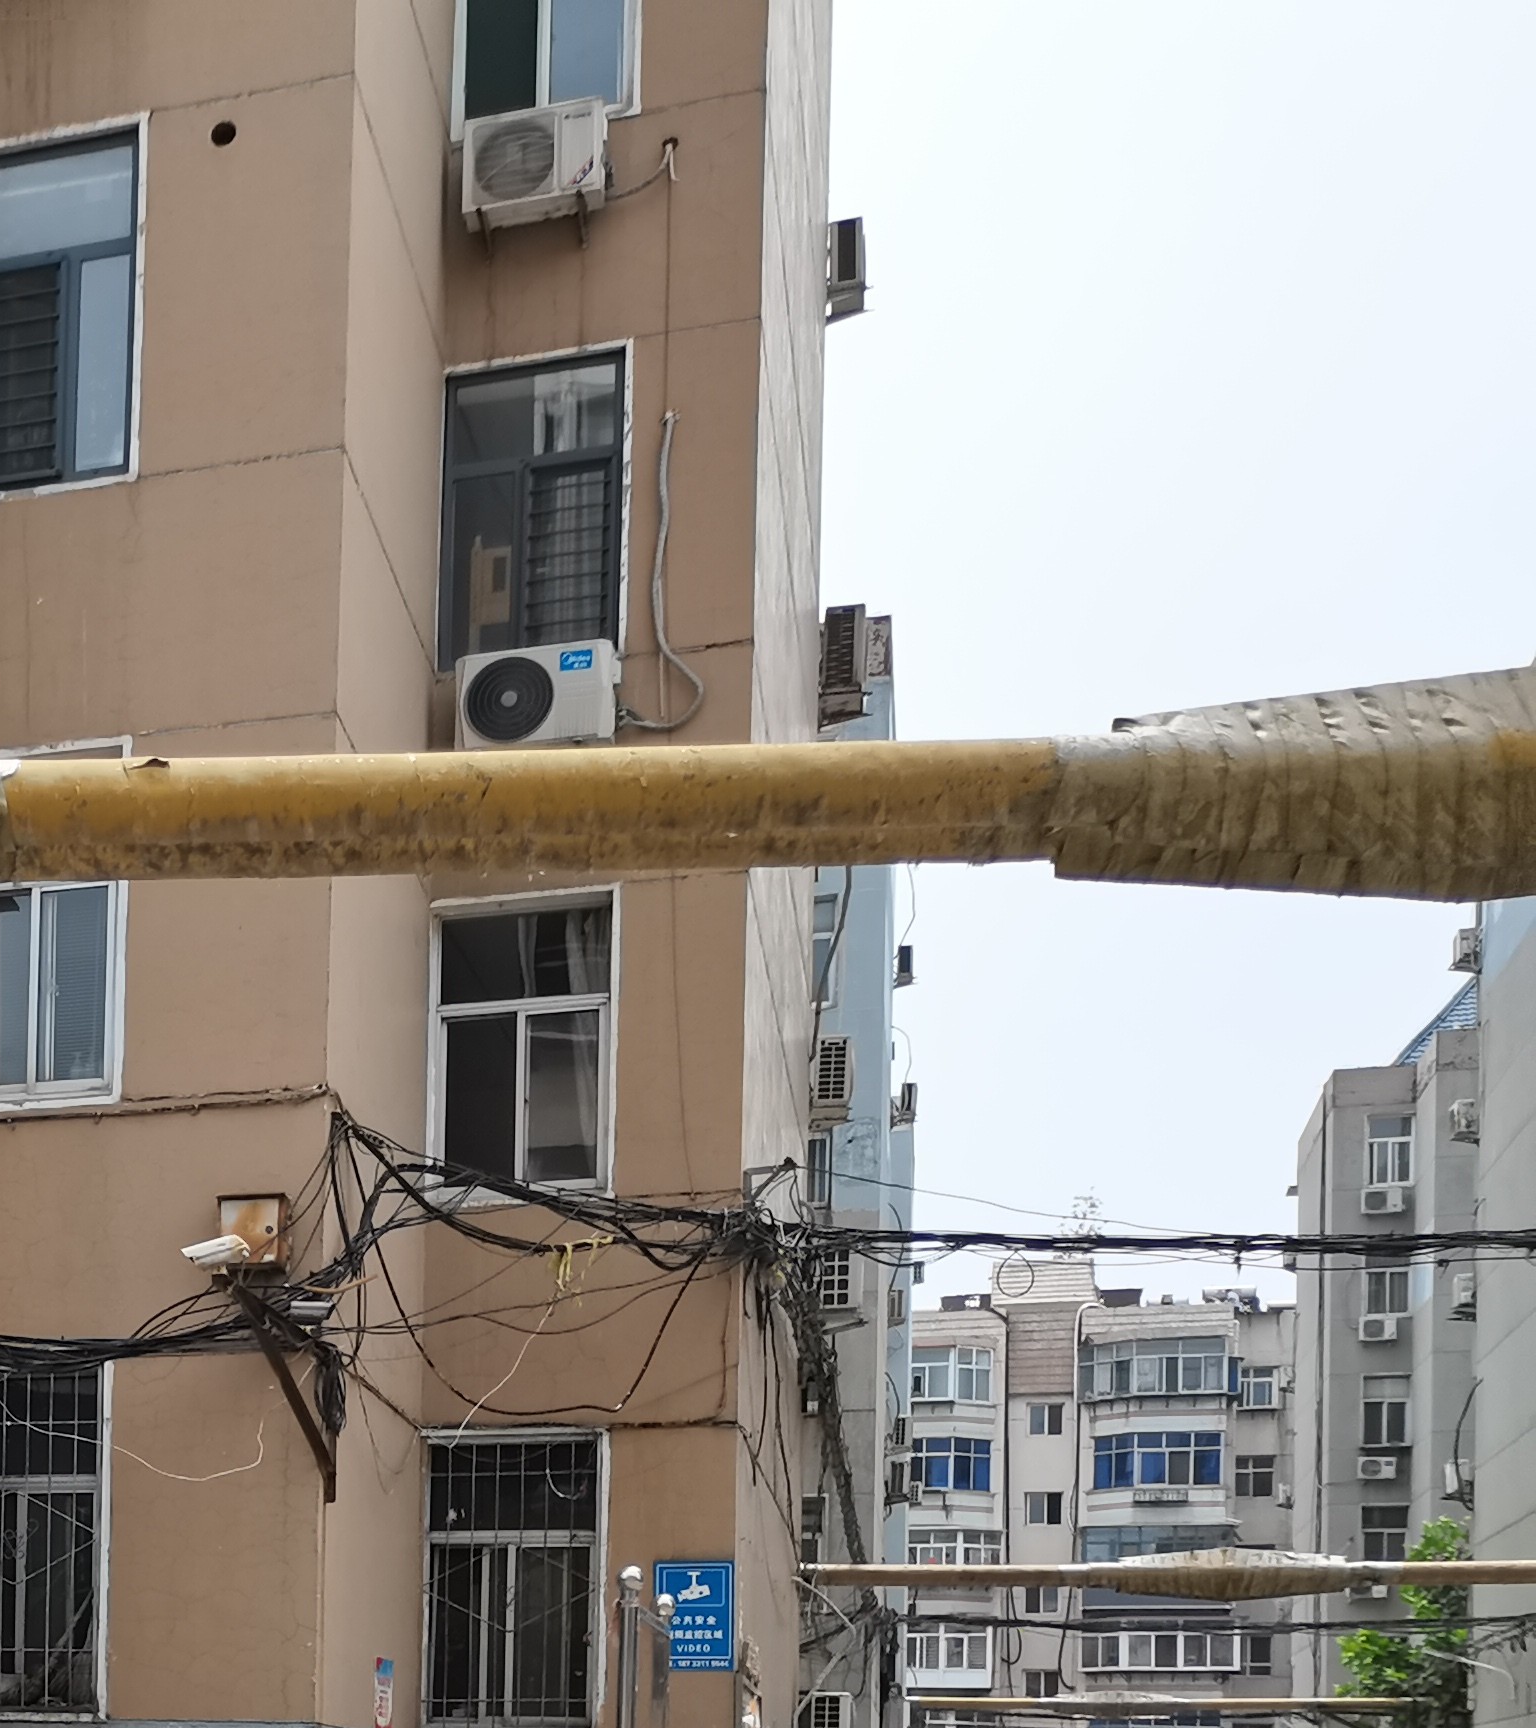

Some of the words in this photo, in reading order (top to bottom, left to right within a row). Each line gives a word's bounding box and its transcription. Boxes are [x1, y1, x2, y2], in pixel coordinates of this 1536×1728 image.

[671, 1615, 717, 1626] 公共安全
[676, 1644, 711, 1653] VIDEO
